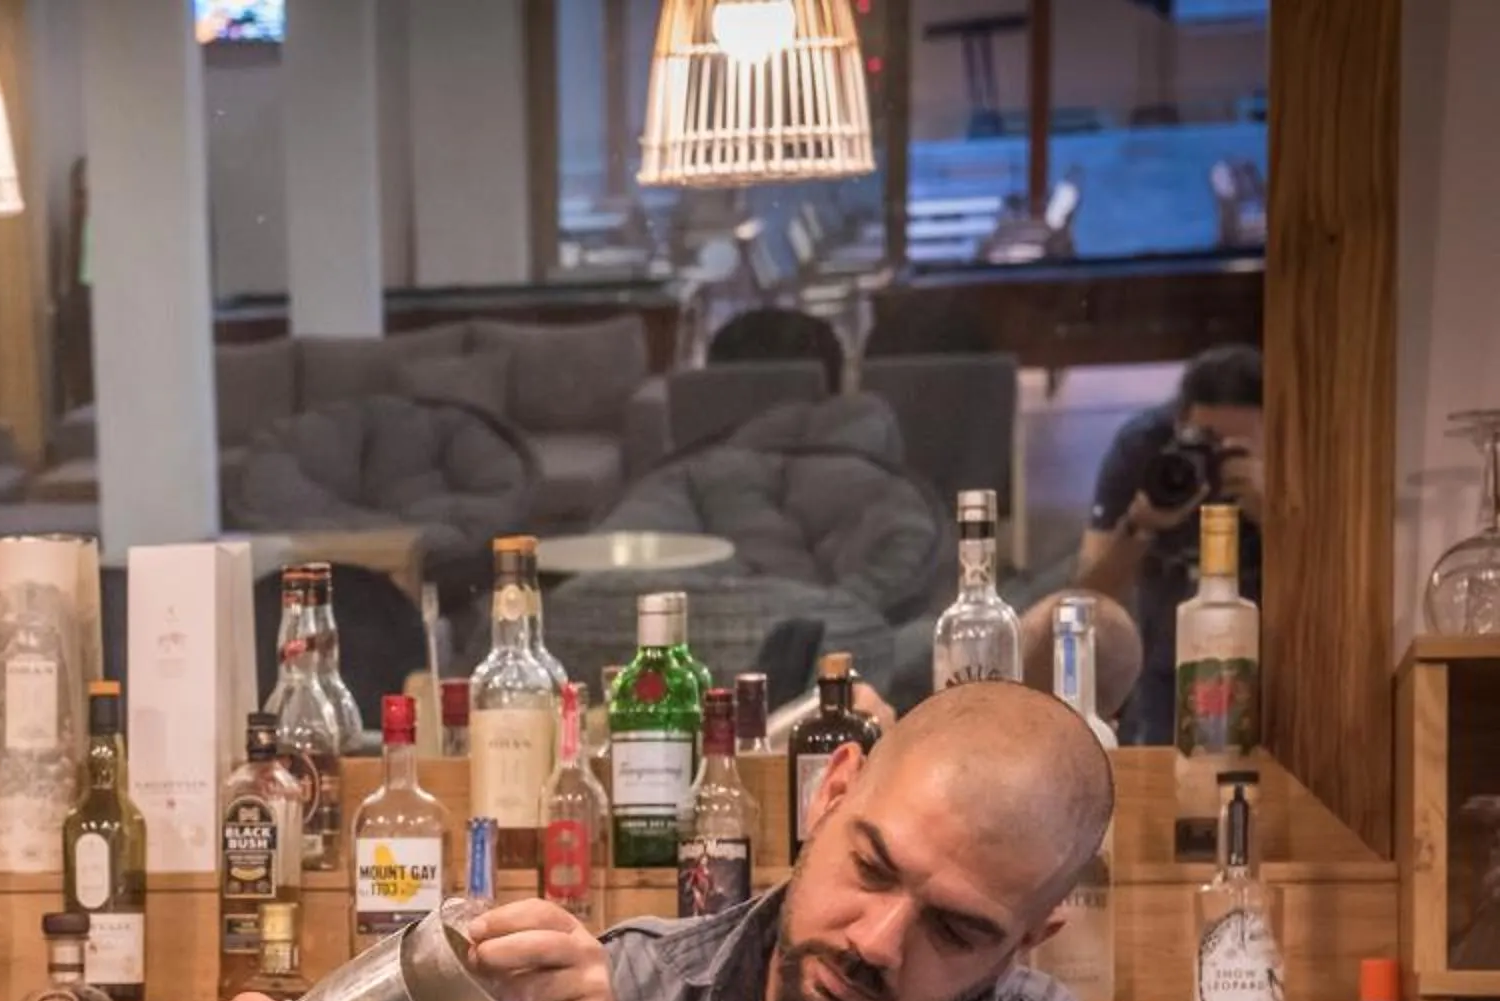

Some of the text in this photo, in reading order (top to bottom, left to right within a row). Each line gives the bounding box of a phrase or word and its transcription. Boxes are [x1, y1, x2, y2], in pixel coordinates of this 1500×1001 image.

[225, 826, 271, 838] BLACK
[227, 838, 268, 849] BUSH
[359, 864, 437, 881] MOUNT GAY
[1216, 968, 1257, 979] SNOW
[1206, 980, 1267, 992] LEOPARD
